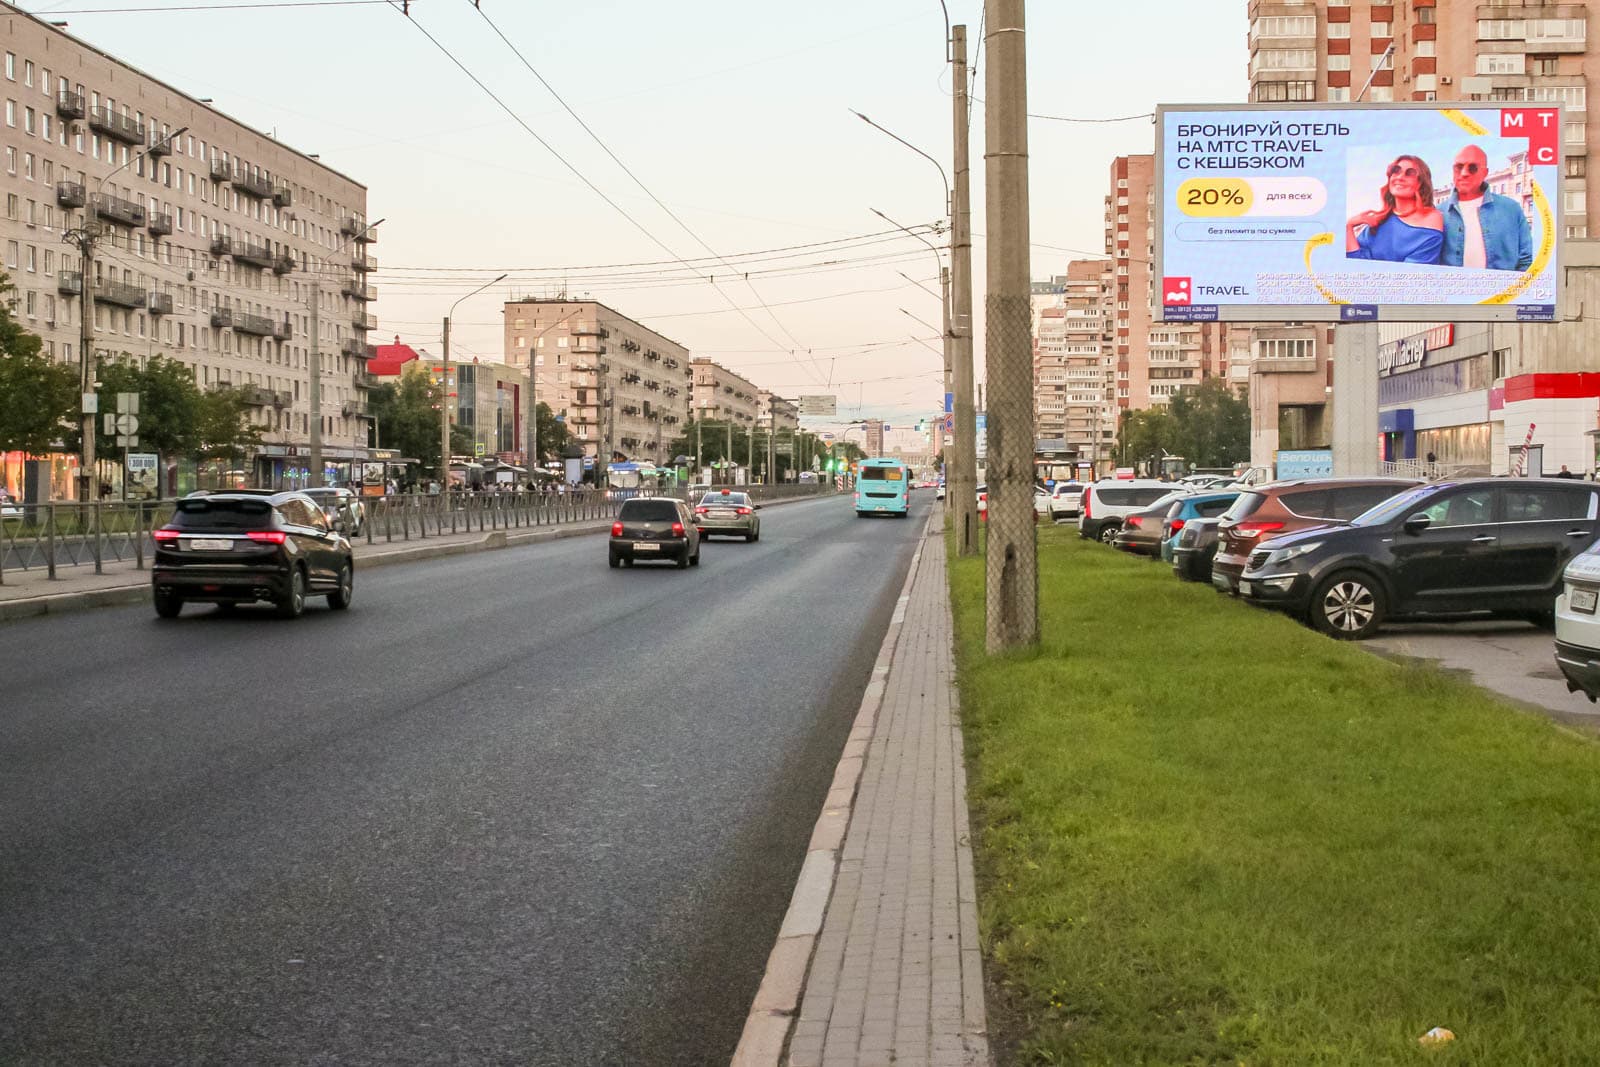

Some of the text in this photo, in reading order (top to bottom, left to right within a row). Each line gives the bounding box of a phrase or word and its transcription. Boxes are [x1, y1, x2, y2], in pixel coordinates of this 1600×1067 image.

[1178, 120, 1350, 137] БРОНИРУЙ ОТЕЛЬ
[1178, 140, 1323, 153] НА МТС TRAVEL
[1177, 156, 1305, 169] С КЕШБЭКОМ
[1187, 188, 1245, 205] 20%
[1266, 192, 1313, 201] для всех
[1208, 227, 1223, 235] без
[1268, 228, 1296, 236] сумме
[1197, 286, 1250, 296] TRAVEL
[1533, 289, 1553, 300] 12+
